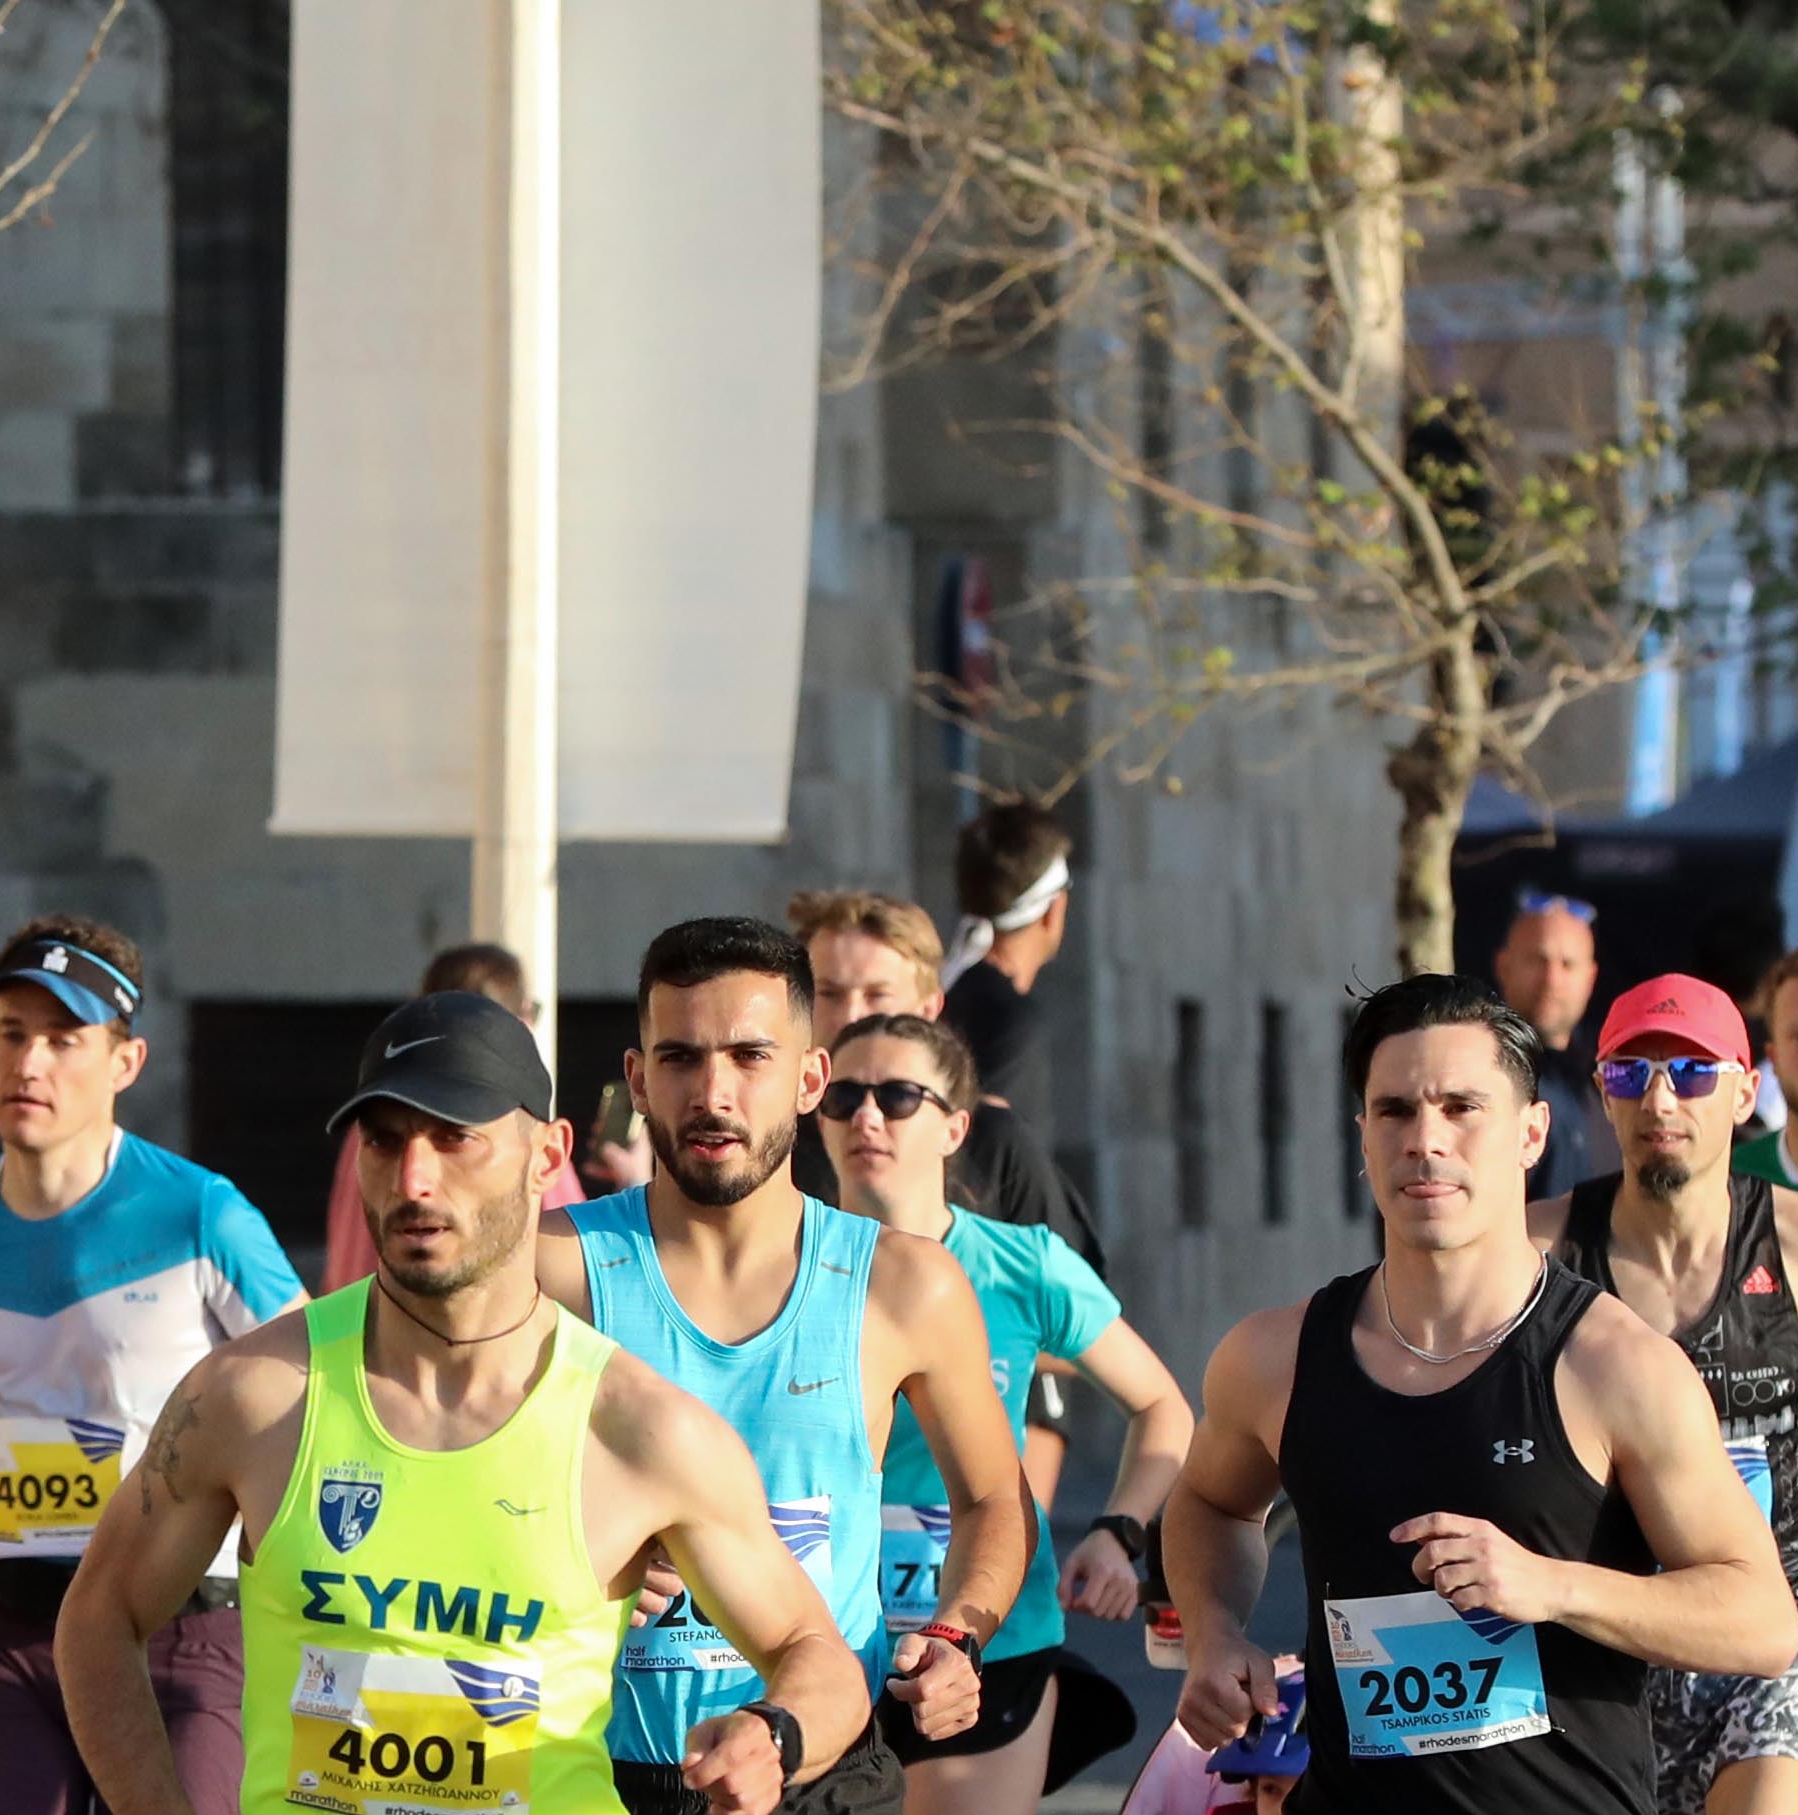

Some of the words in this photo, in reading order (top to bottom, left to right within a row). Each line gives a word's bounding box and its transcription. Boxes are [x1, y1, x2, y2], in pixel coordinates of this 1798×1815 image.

[301, 1569, 545, 1645] ΣΥΜΗ
[625, 1645, 646, 1657] half
[625, 1656, 685, 1667] marathon
[1359, 1655, 1505, 1717] 2037
[1381, 1712, 1450, 1732] TSAMPIKOS
[1452, 1706, 1492, 1723] STATIS
[1418, 1722, 1527, 1750] #rhodesmarathon
[328, 1728, 486, 1787] 4001
[321, 1770, 383, 1793] ΜΙΧΑΛΗΣ
[290, 1788, 358, 1813] marathon
